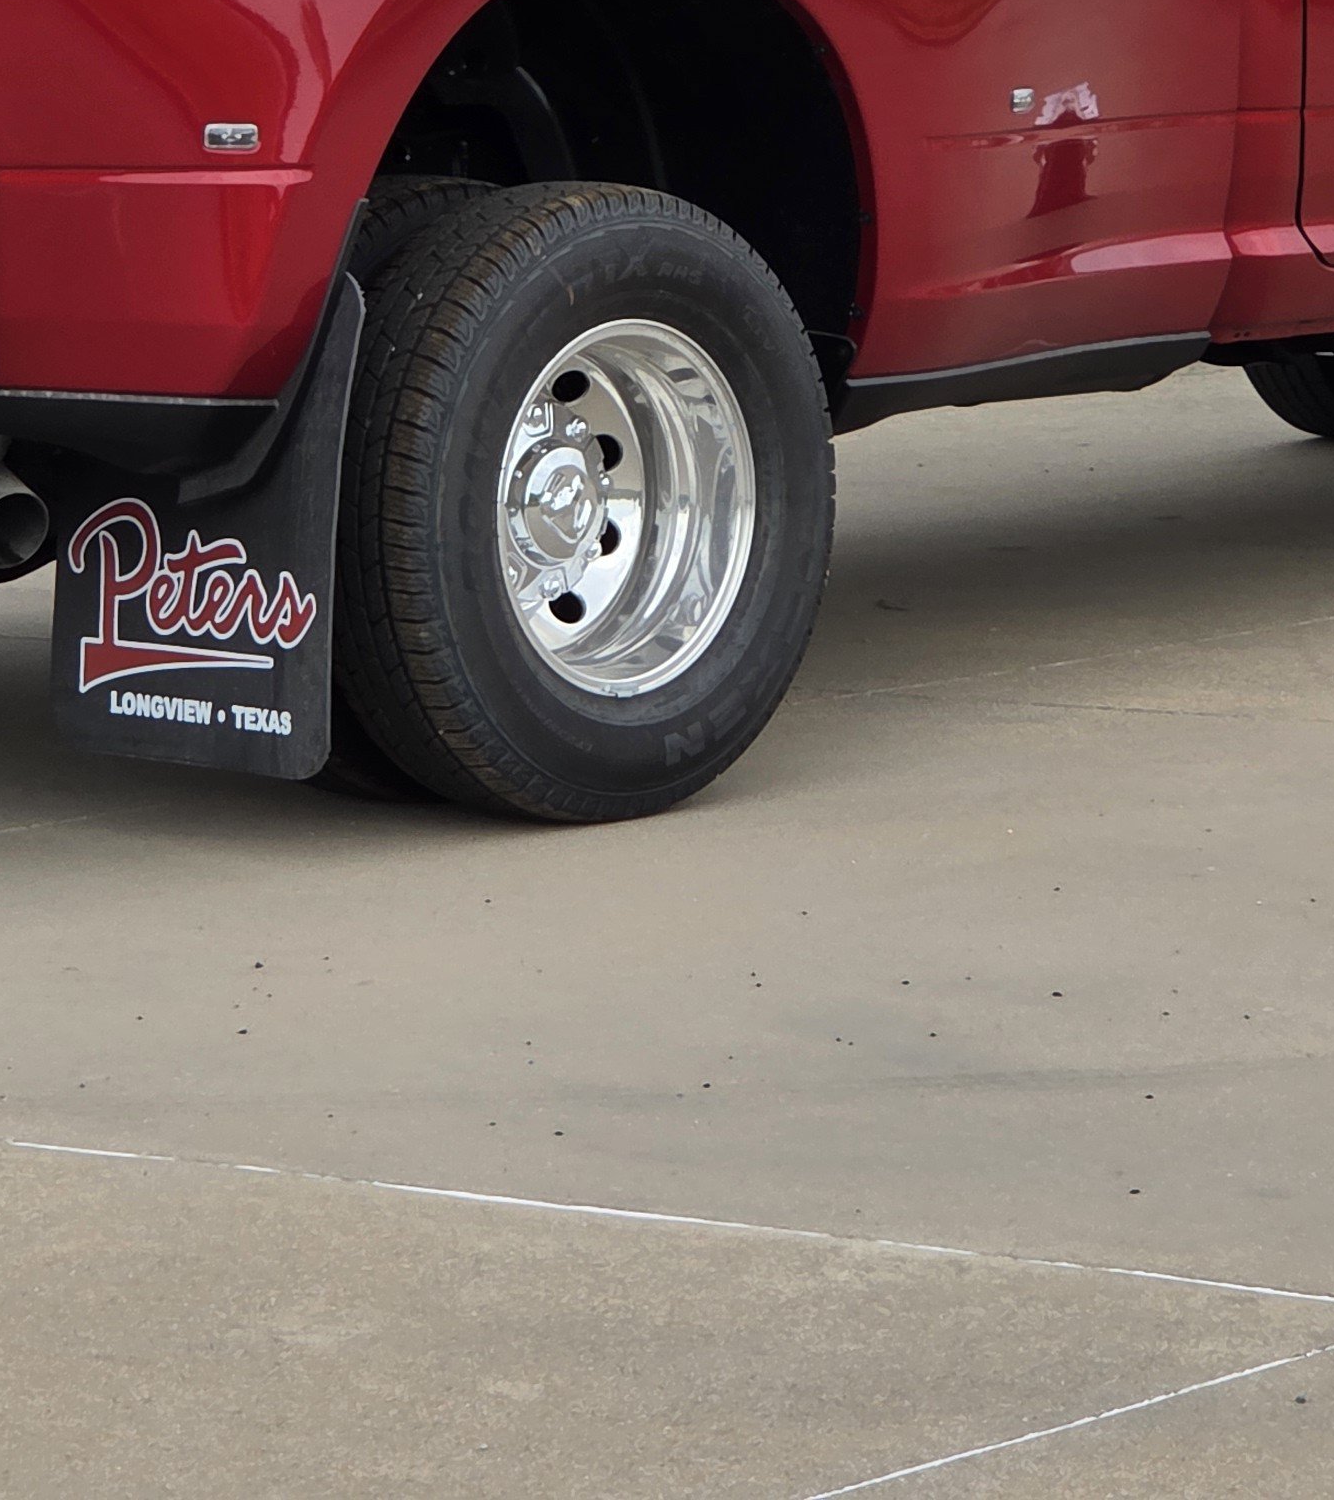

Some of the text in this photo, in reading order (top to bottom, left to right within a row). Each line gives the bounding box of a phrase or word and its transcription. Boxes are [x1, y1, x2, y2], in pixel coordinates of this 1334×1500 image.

[68, 497, 316, 650] Peters
[110, 690, 293, 736] LONGVIEW TEXAS
